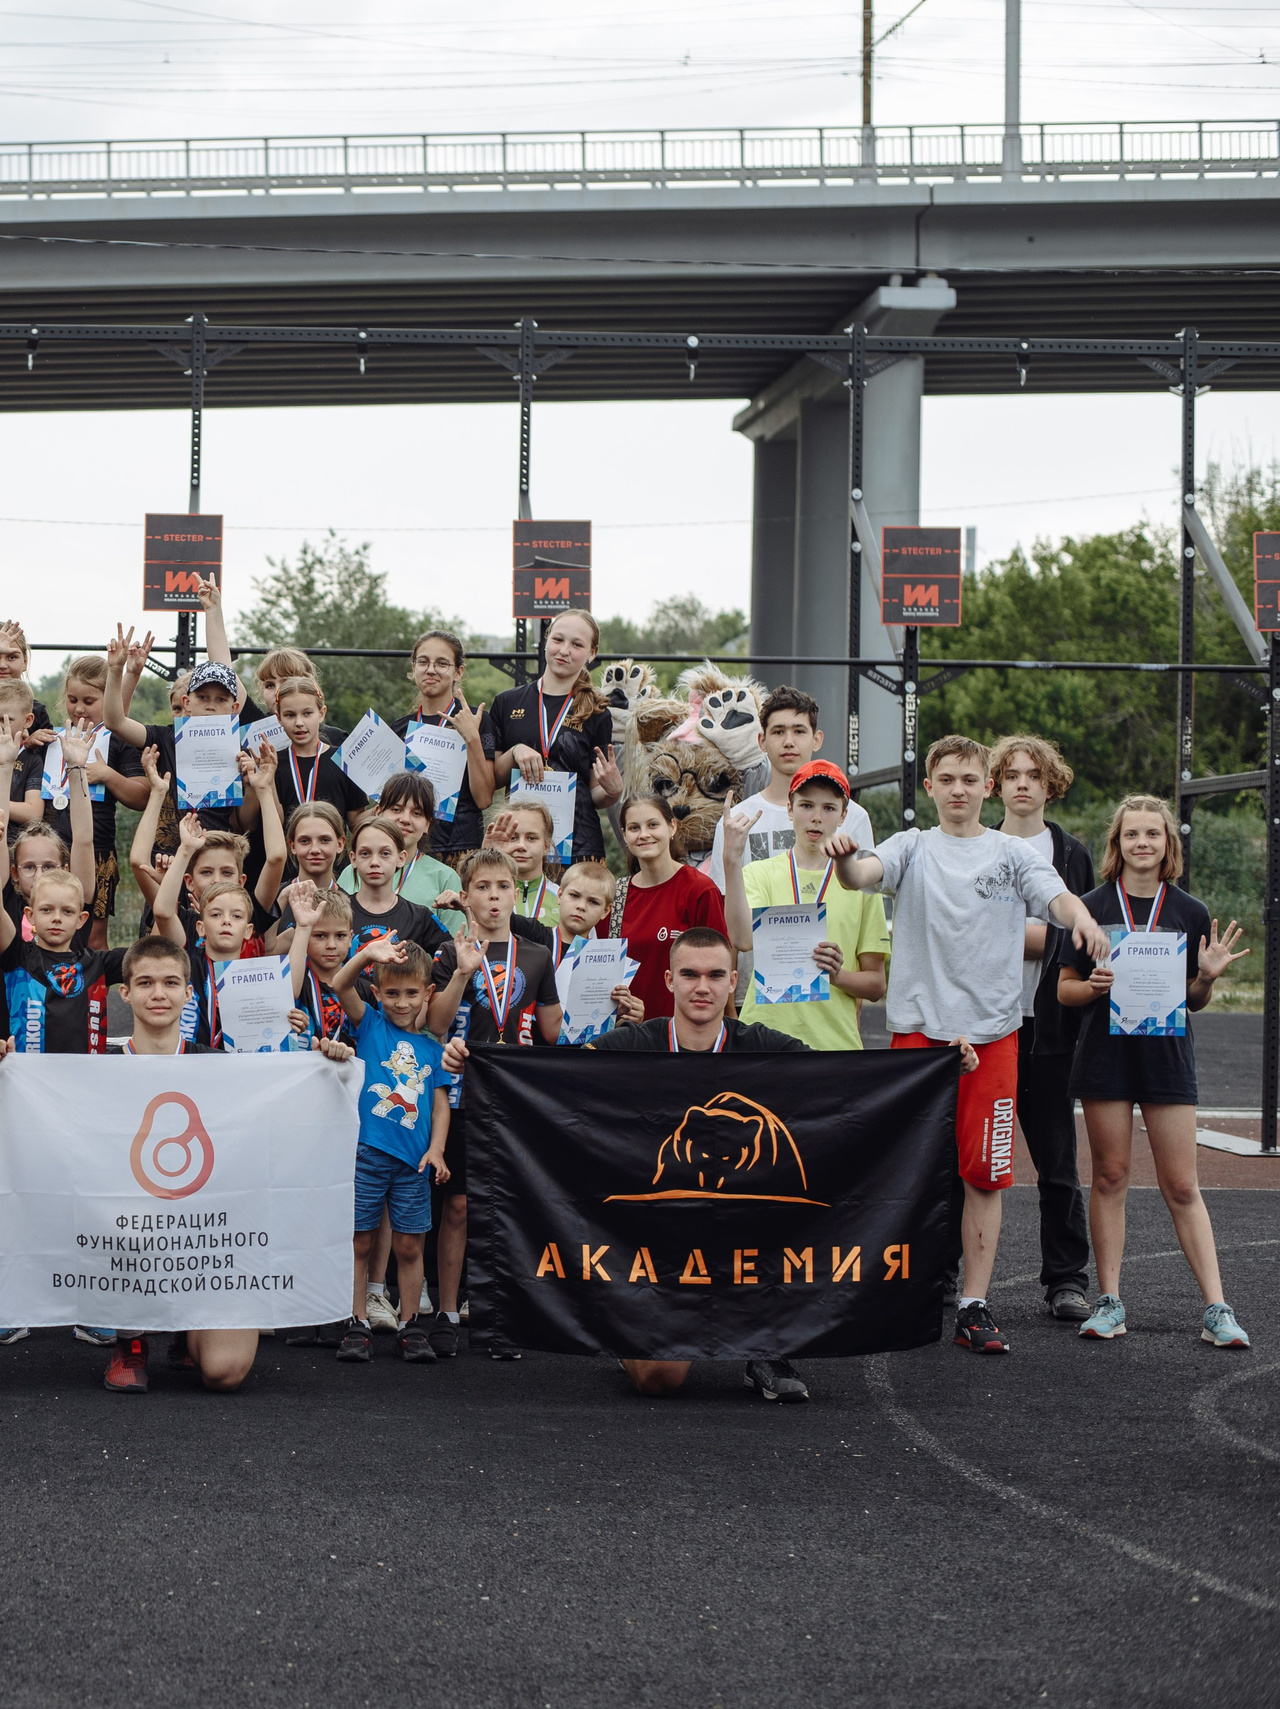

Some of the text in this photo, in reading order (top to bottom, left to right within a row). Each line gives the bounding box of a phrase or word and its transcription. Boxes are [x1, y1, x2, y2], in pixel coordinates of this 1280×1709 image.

[164, 534, 203, 542] STECTER
[901, 547, 942, 555] STECTER
[189, 728, 226, 738] ГРАМОТА
[348, 728, 374, 760] ГРАМОТА
[419, 736, 455, 750] ГРАМОТА
[525, 784, 562, 792] ГРАМОТА
[768, 916, 810, 924] ГРАМОТА
[585, 954, 615, 963] ГРАМОТА
[1128, 947, 1170, 956] ГРАМОТА
[232, 972, 274, 984] ГРАМОТА
[26, 998, 42, 1053] RKOUT
[991, 1098, 1013, 1182] ORIGINAL
[116, 1212, 227, 1232] ФЕДЕРАЦИЯ
[76, 1232, 268, 1254] ФУНКЦИОНАЛЬНОГО
[110, 1254, 234, 1272] МНОГОБОРЬЯ
[536, 1242, 910, 1284] АКАДЕМИЯ
[52, 1272, 294, 1296] ВОЛГОГРАДСКОЙ ОБЛАСТИ
